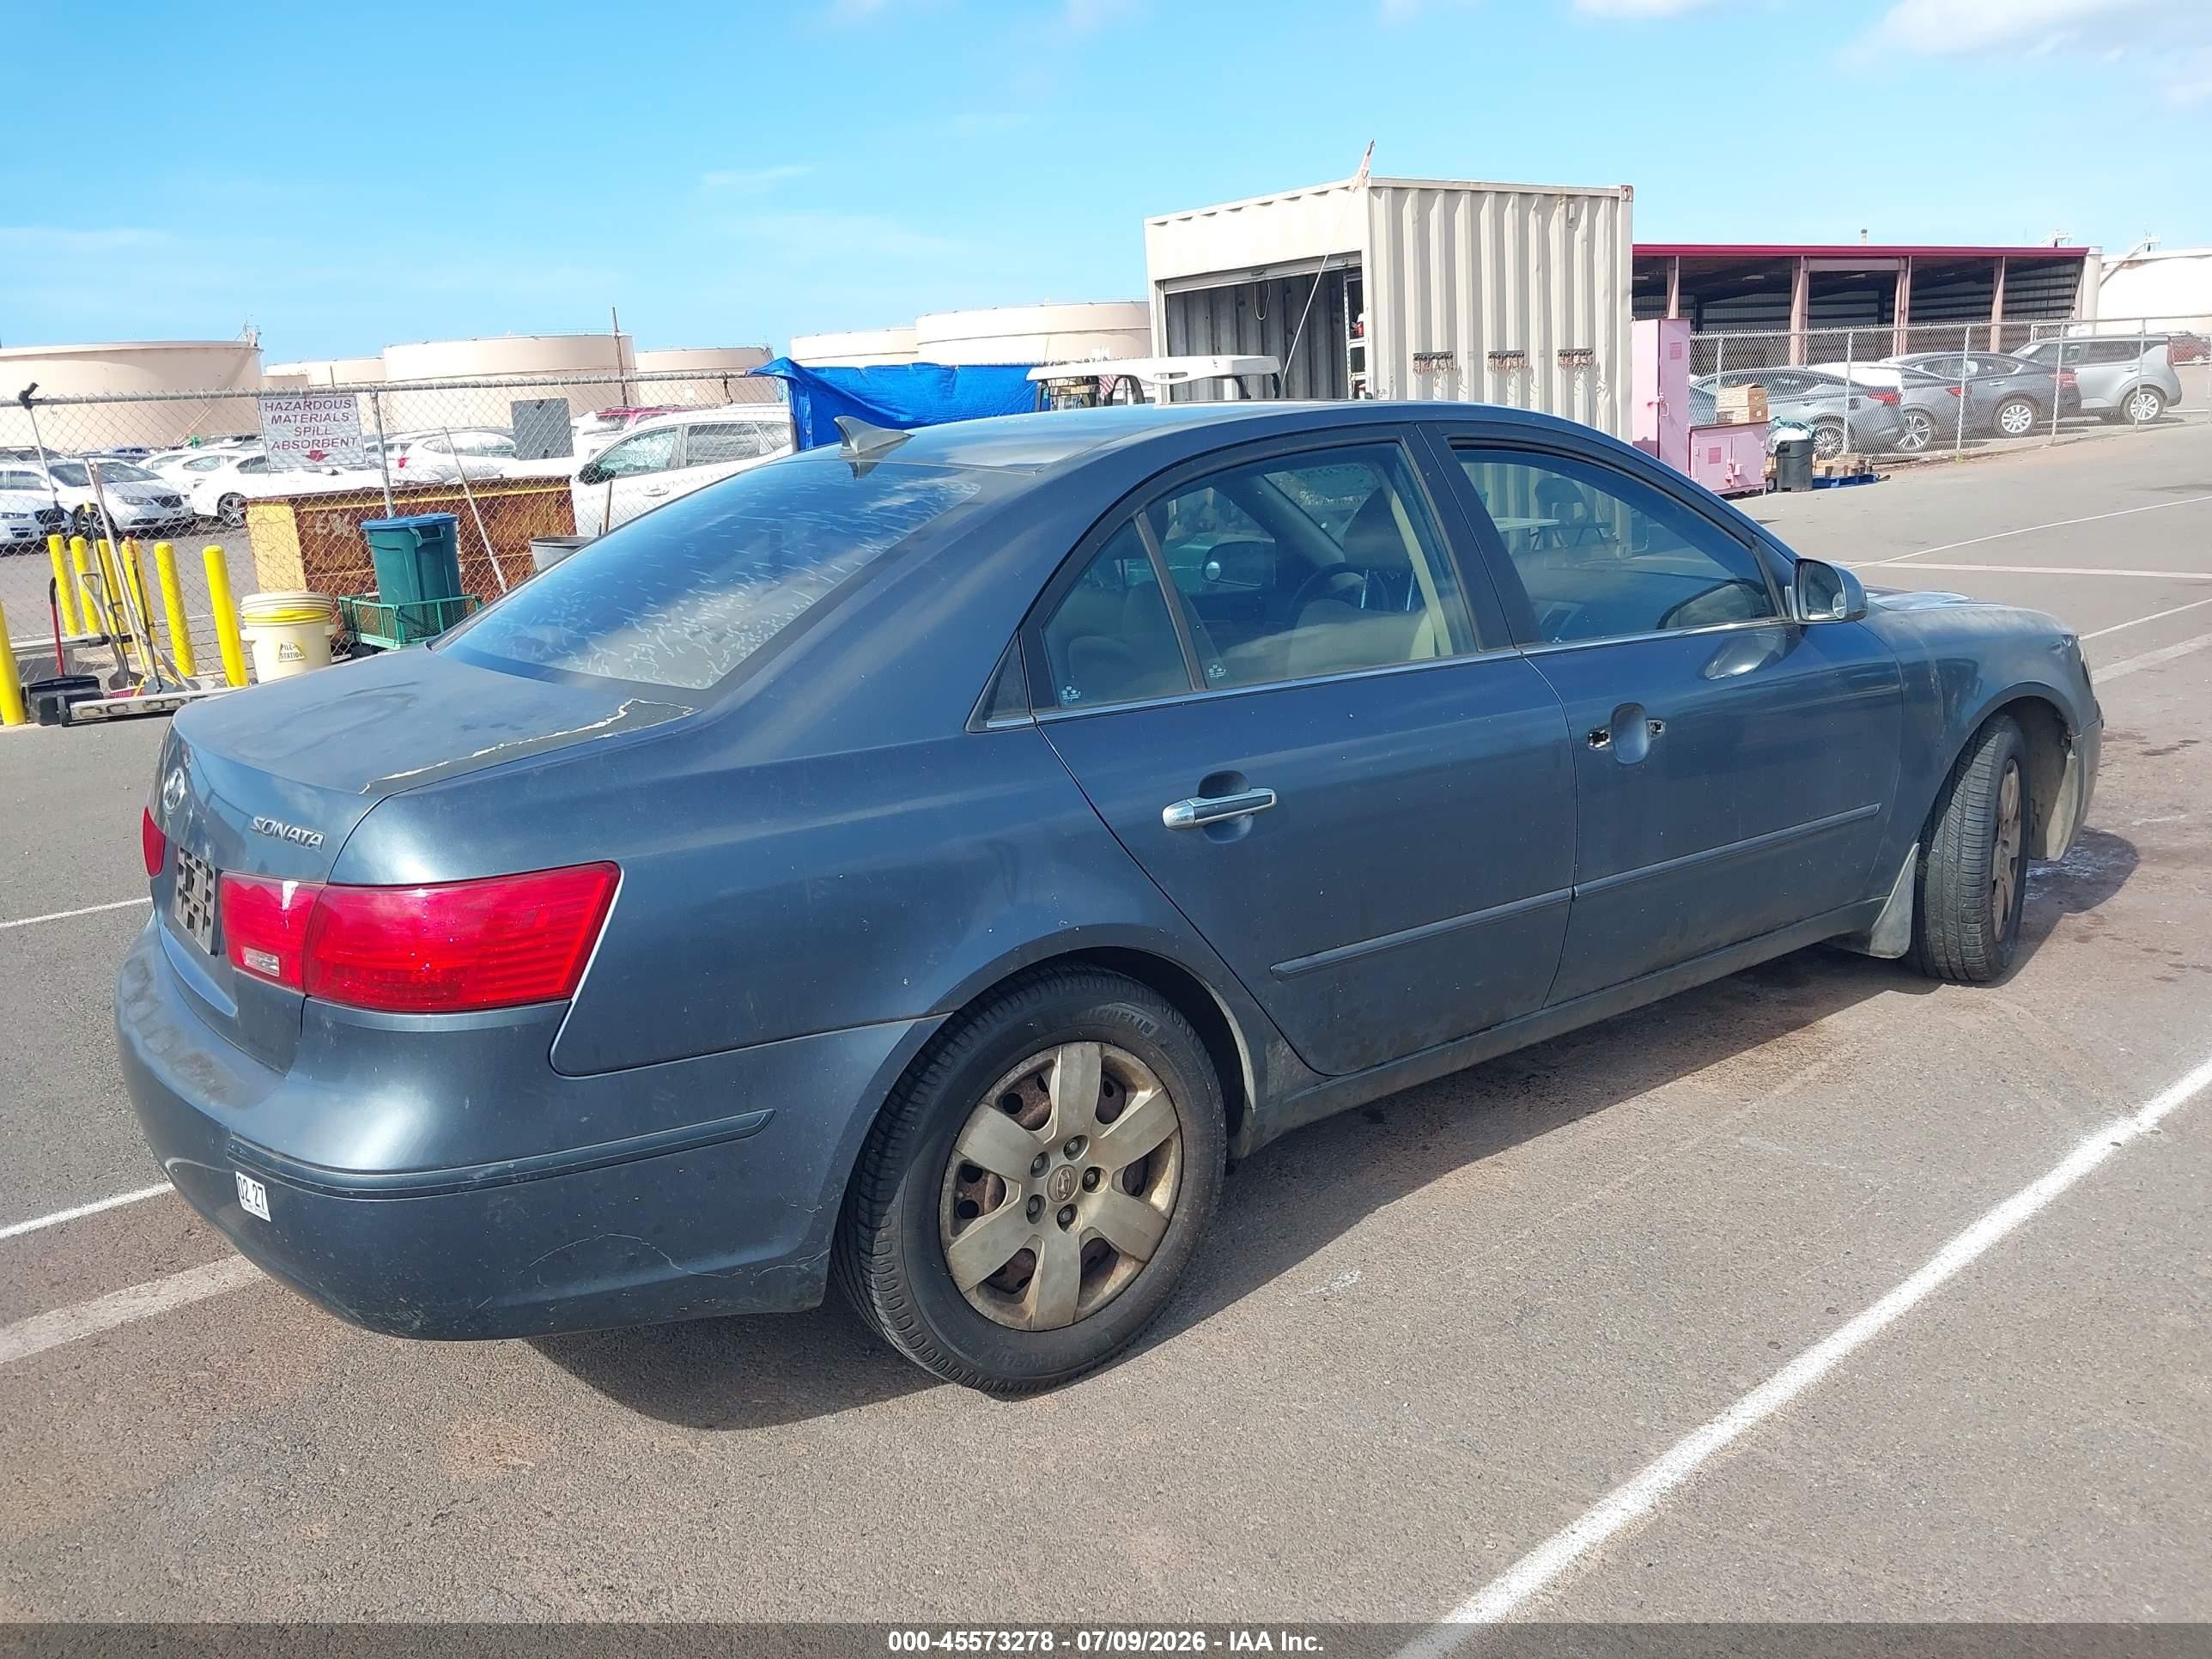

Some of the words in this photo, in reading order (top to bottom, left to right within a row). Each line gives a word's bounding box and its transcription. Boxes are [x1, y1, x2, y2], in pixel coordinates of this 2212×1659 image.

[264, 399, 352, 412] HAZARDOUS
[270, 412, 349, 424] MATERIALS
[294, 426, 331, 436] SPILL
[271, 437, 357, 450] ABSORBENT
[251, 816, 326, 852] SONATA
